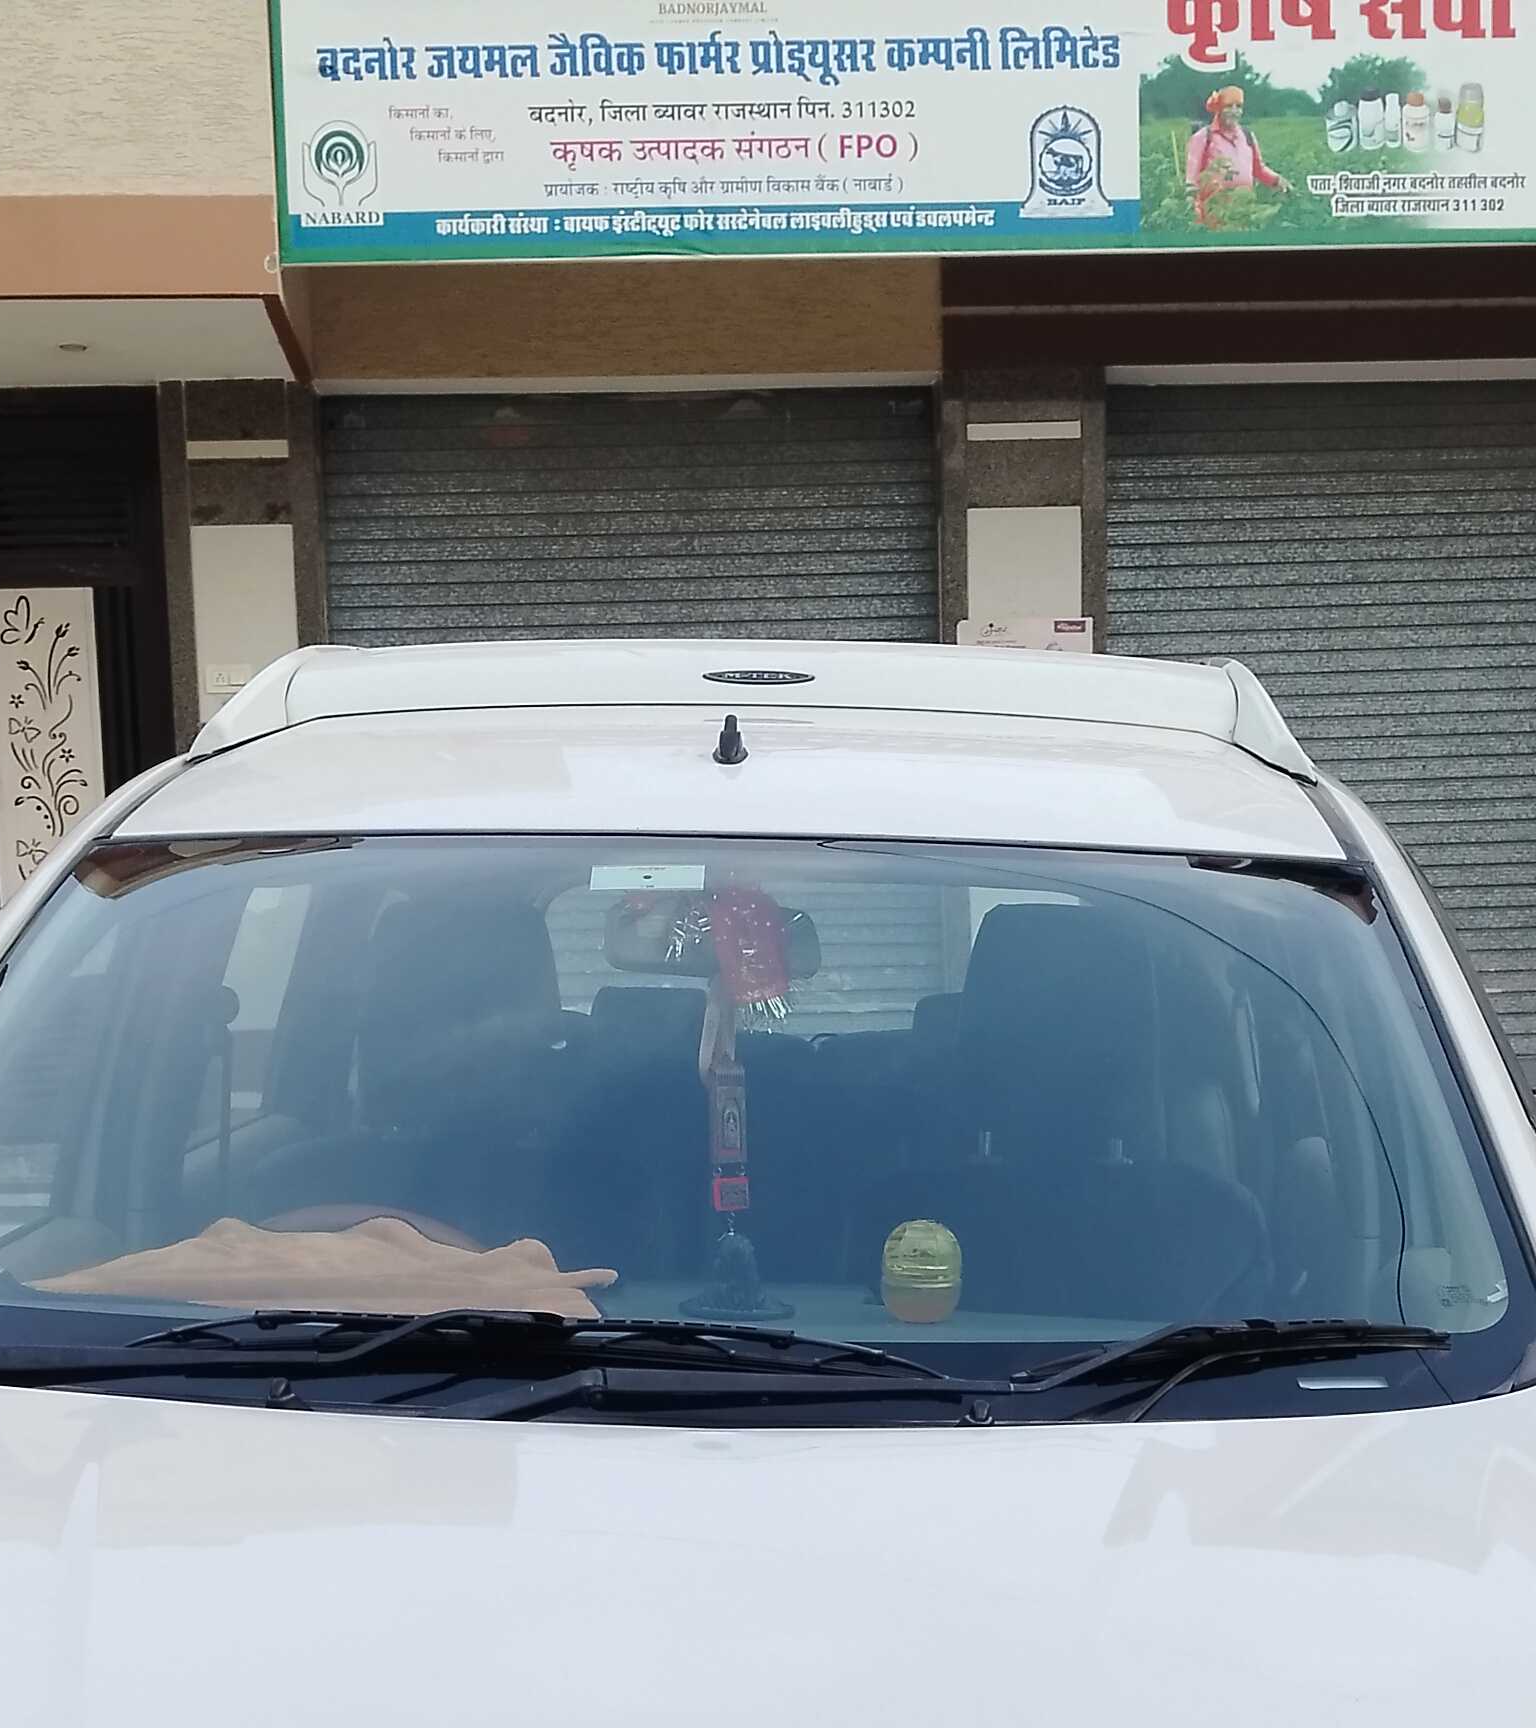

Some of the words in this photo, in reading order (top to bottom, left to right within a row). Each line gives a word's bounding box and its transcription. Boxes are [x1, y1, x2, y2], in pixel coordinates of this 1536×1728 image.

[658, 2, 767, 16] BADNORJAYMAL
[316, 37, 417, 81] बदनोर
[425, 44, 541, 79] जयमल
[548, 32, 645, 77] जैविक
[654, 30, 741, 75] फार्मर
[885, 27, 991, 71] कम्पनी
[999, 25, 1120, 70] लिमिटेड
[528, 99, 593, 126] बदनोर,
[600, 98, 647, 122] जिला
[712, 101, 791, 121] राजस्थान
[797, 96, 834, 119] पिन.
[842, 100, 916, 118] 311302
[550, 140, 623, 171] कृषक
[630, 139, 725, 163] उत्पादक
[732, 131, 811, 160] संगठन
[544, 179, 599, 198] प्रायोजक
[658, 177, 687, 199] कृषि
[691, 176, 714, 195] और
[720, 175, 762, 194] ग्रामीण
[766, 175, 811, 192] विकास
[1339, 174, 1380, 191] शिवाजी
[1383, 177, 1407, 190] नगर
[1409, 173, 1445, 189] बदनोर
[1448, 173, 1488, 189] तहसील
[1491, 172, 1526, 189] बदनोर
[1335, 197, 1364, 213] जिला
[1401, 198, 1450, 212] राजस्थान
[304, 211, 381, 225] NABARD
[435, 213, 506, 236] कार्यकारी
[508, 212, 548, 234] संस्था
[683, 209, 714, 231] फोर
[890, 206, 915, 227] एवं
